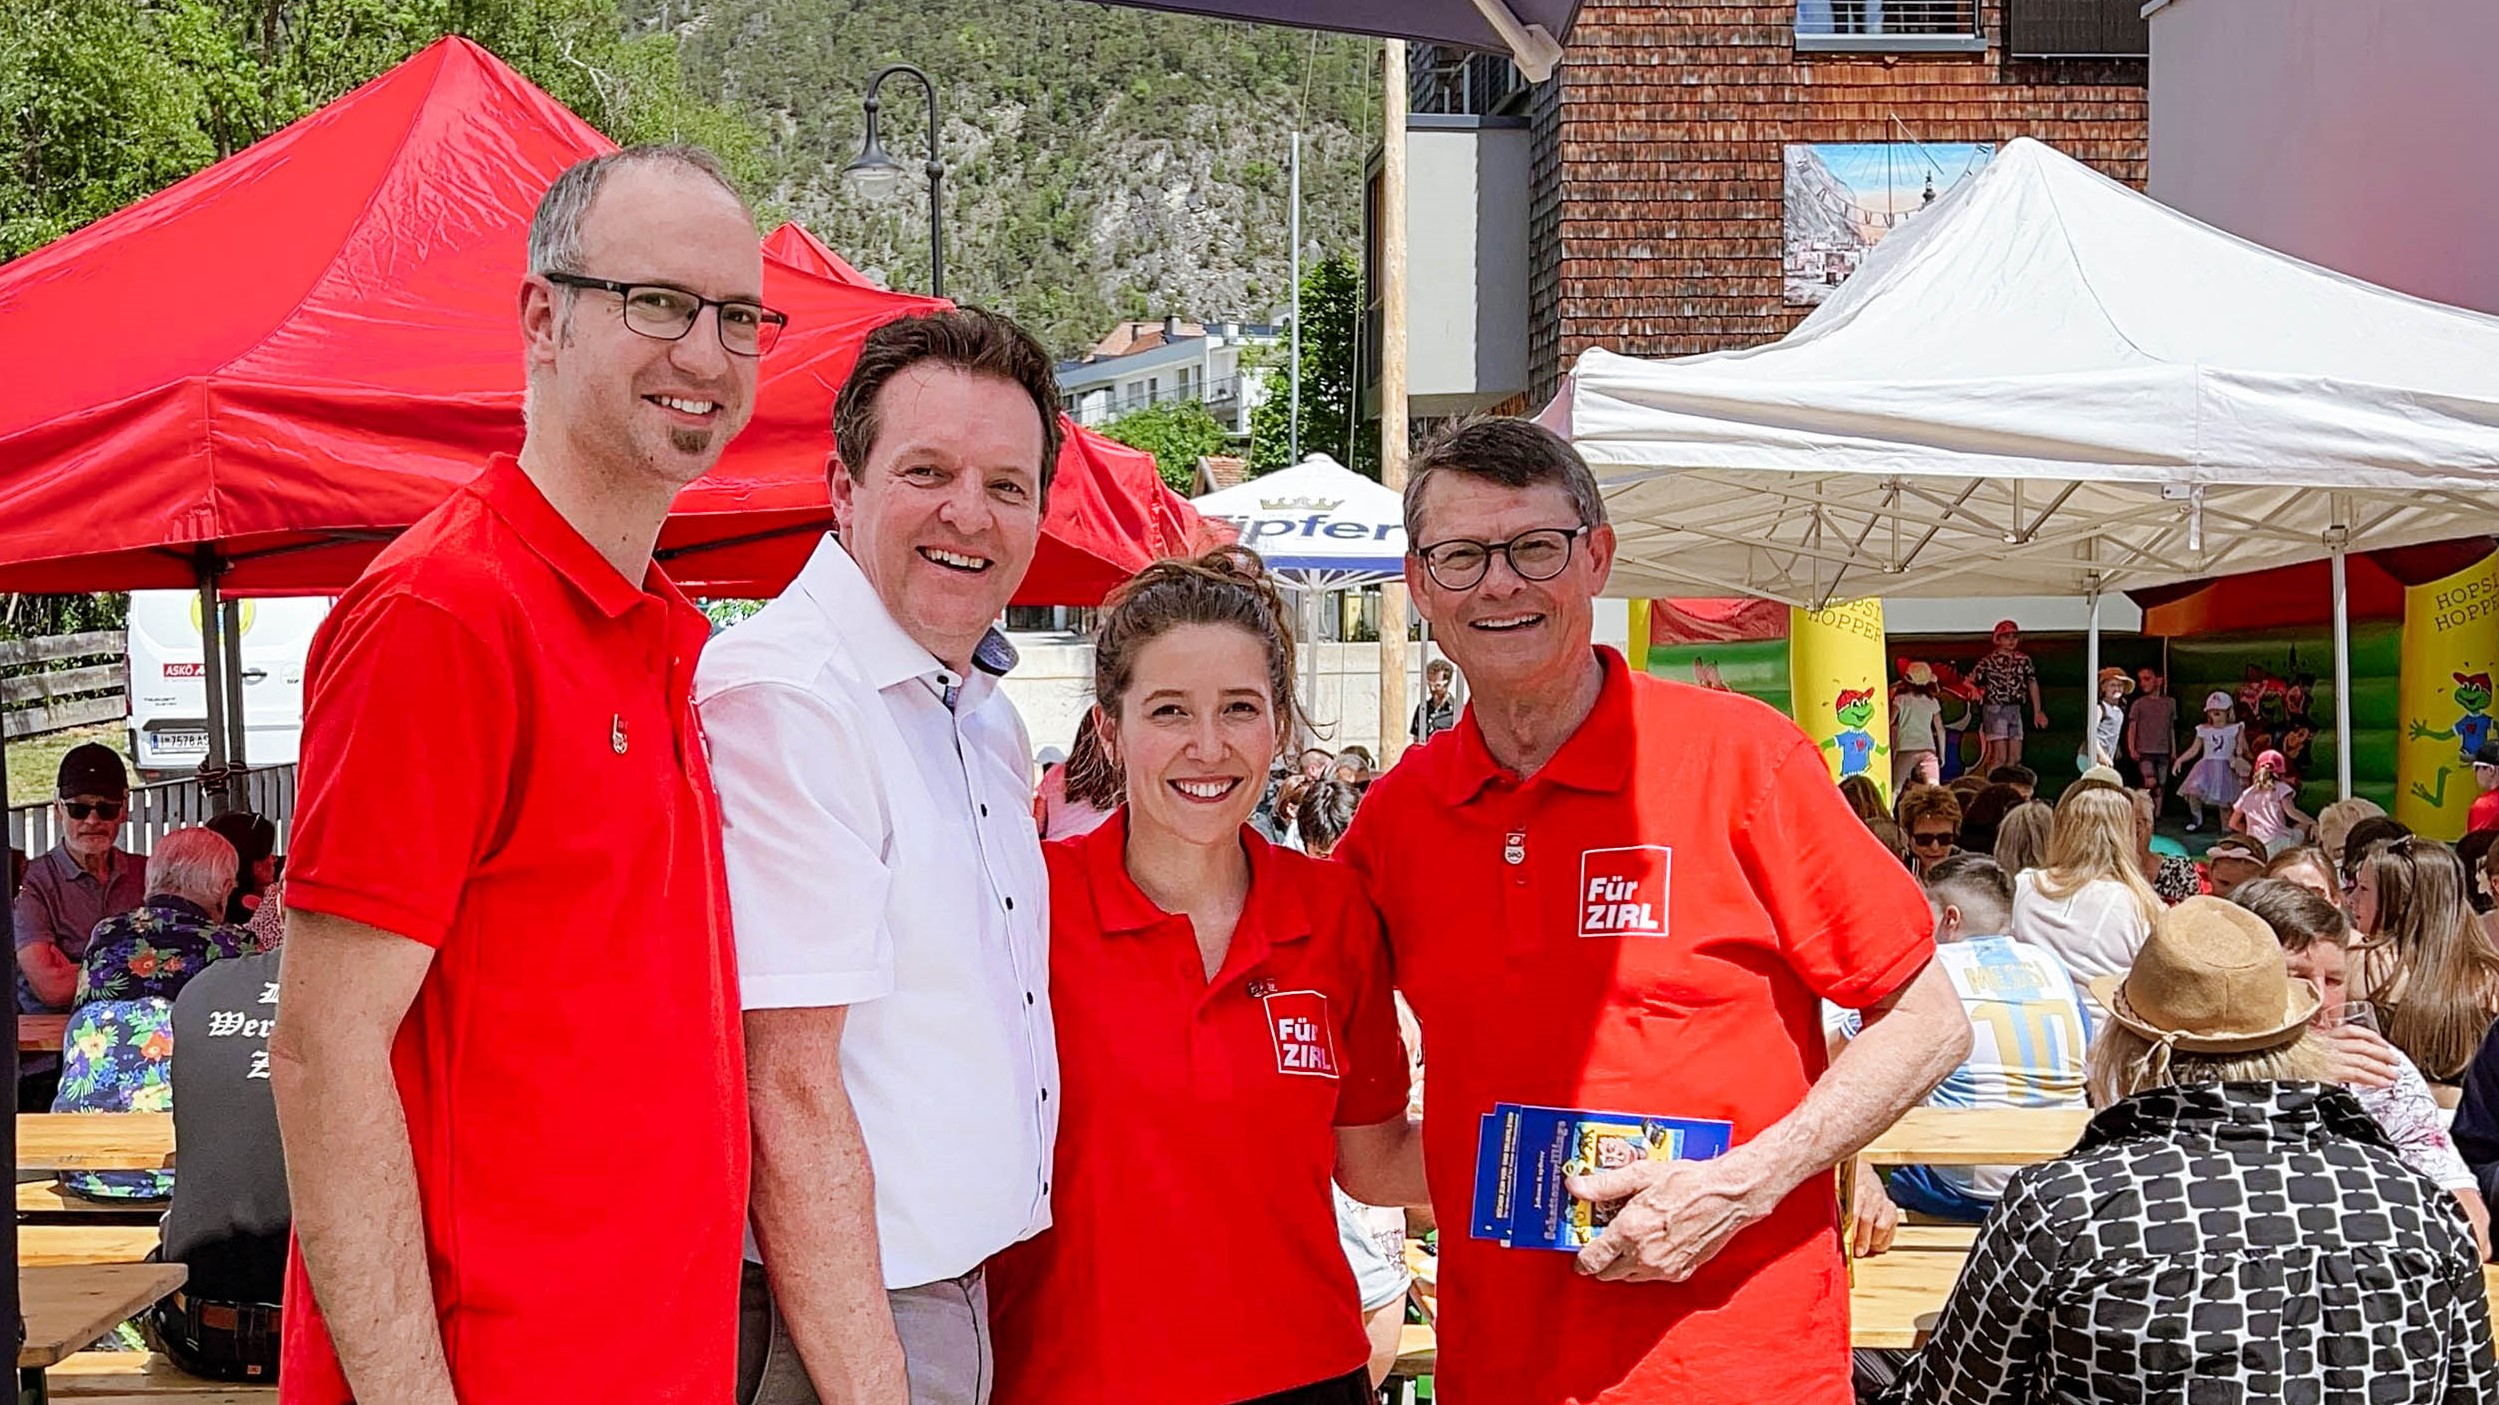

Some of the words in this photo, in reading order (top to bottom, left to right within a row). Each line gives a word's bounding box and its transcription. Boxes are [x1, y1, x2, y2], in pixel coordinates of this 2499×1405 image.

[165, 664, 194, 676] ASKÖ
[1587, 876, 1638, 901] Für
[1585, 903, 1658, 930] ZIRL
[1279, 1017, 1318, 1041] Für
[1283, 1043, 1331, 1070] ZIRL
